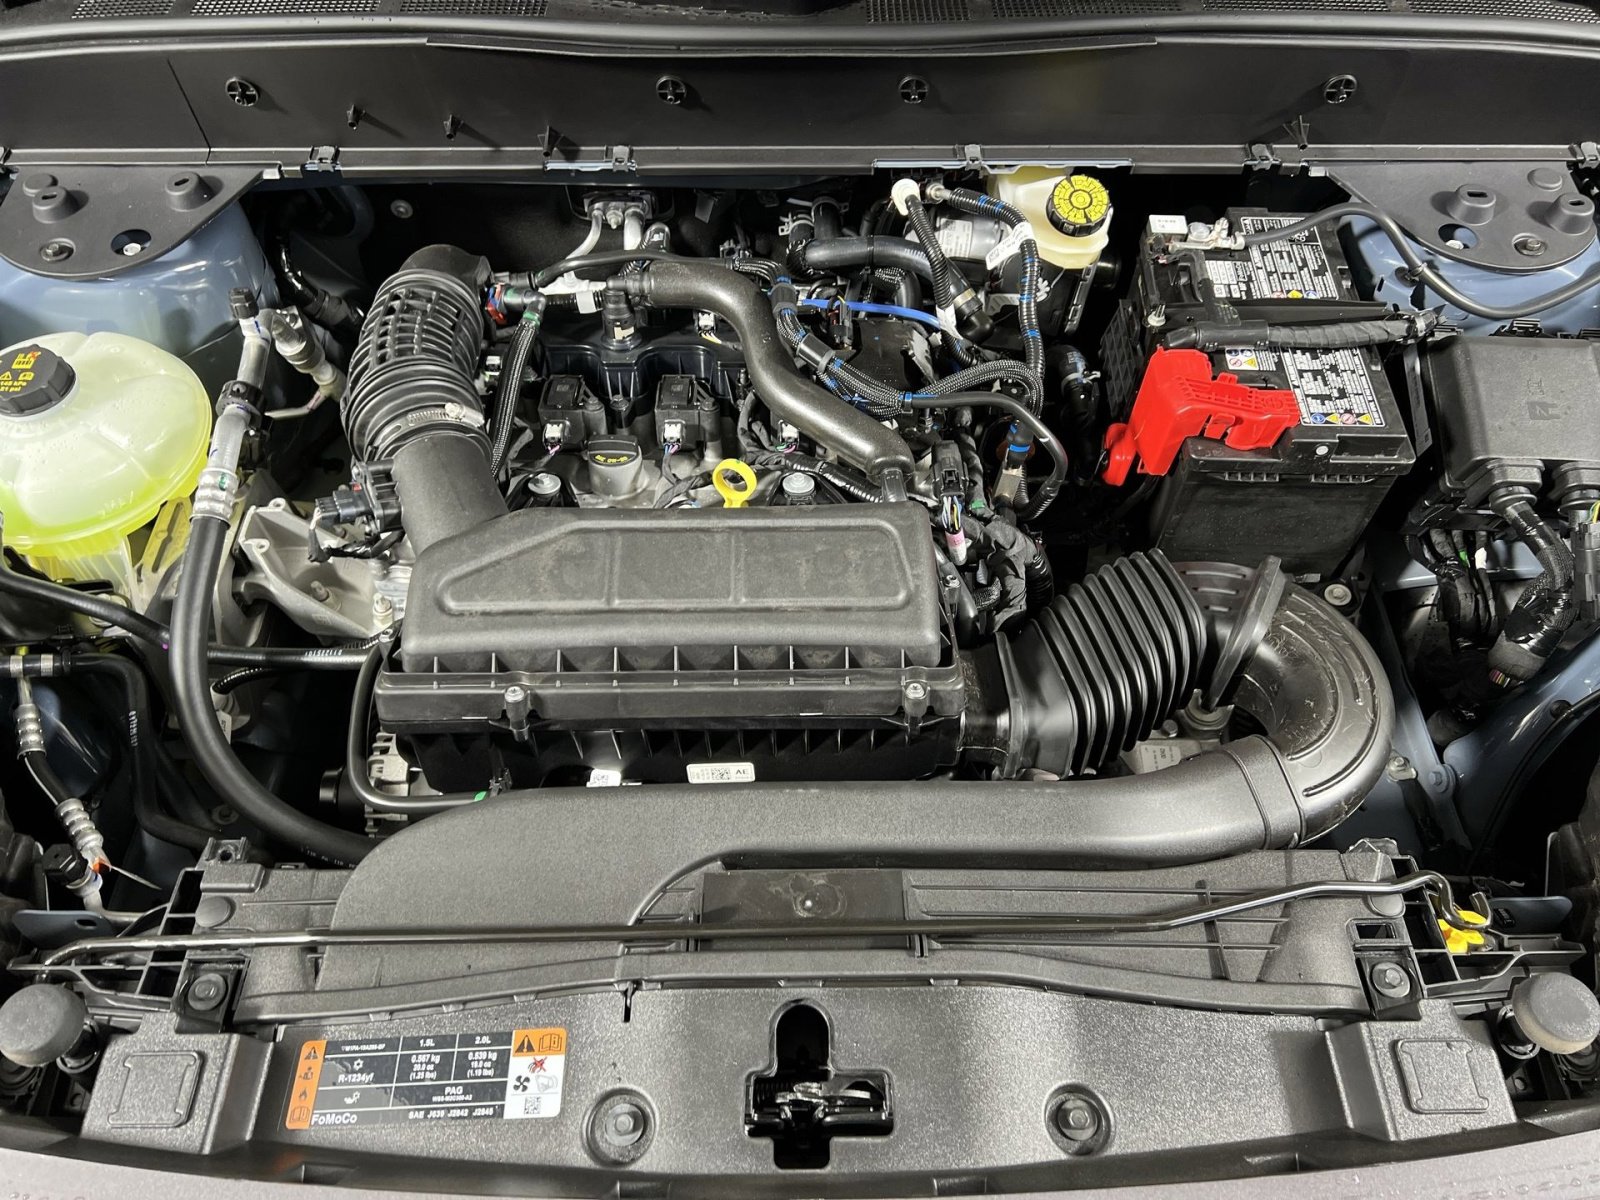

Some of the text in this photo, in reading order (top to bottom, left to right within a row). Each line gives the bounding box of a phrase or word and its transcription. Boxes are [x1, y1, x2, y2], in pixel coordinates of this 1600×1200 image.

[419, 1038, 435, 1047] 1.5L
[474, 1036, 491, 1045] 2.0L
[431, 1053, 441, 1064] kg
[488, 1051, 498, 1062] kg
[338, 1072, 374, 1083] R-1234yf
[444, 1085, 463, 1095] PAG
[311, 1112, 358, 1126] FoMoCo
